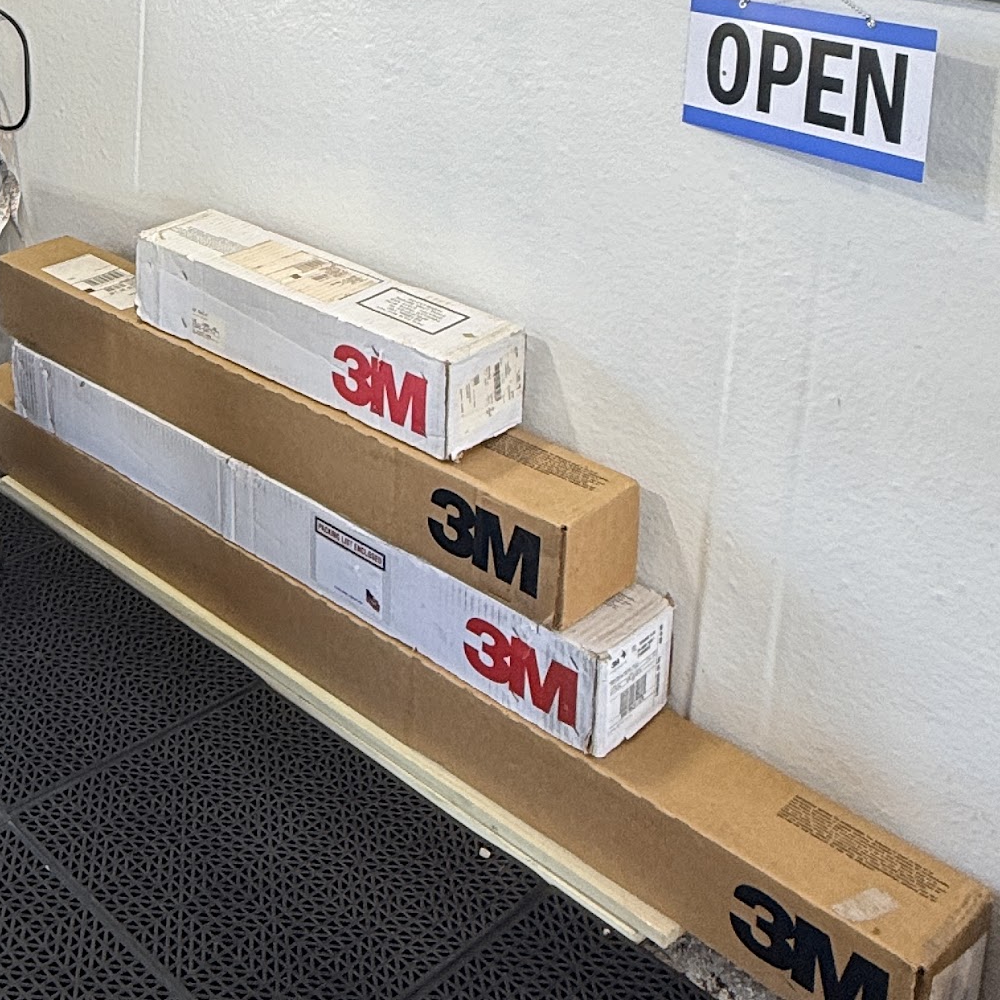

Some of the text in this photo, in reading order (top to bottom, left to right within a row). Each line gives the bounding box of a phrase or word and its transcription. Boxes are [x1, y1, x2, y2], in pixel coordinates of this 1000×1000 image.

[707, 22, 909, 145] OPEN
[331, 344, 428, 437] 3M
[317, 523, 340, 542] PACKING
[353, 543, 383, 565] ENCLOSED
[427, 488, 541, 599] 3M
[463, 617, 578, 728] 3M
[729, 884, 890, 1000] 3M
